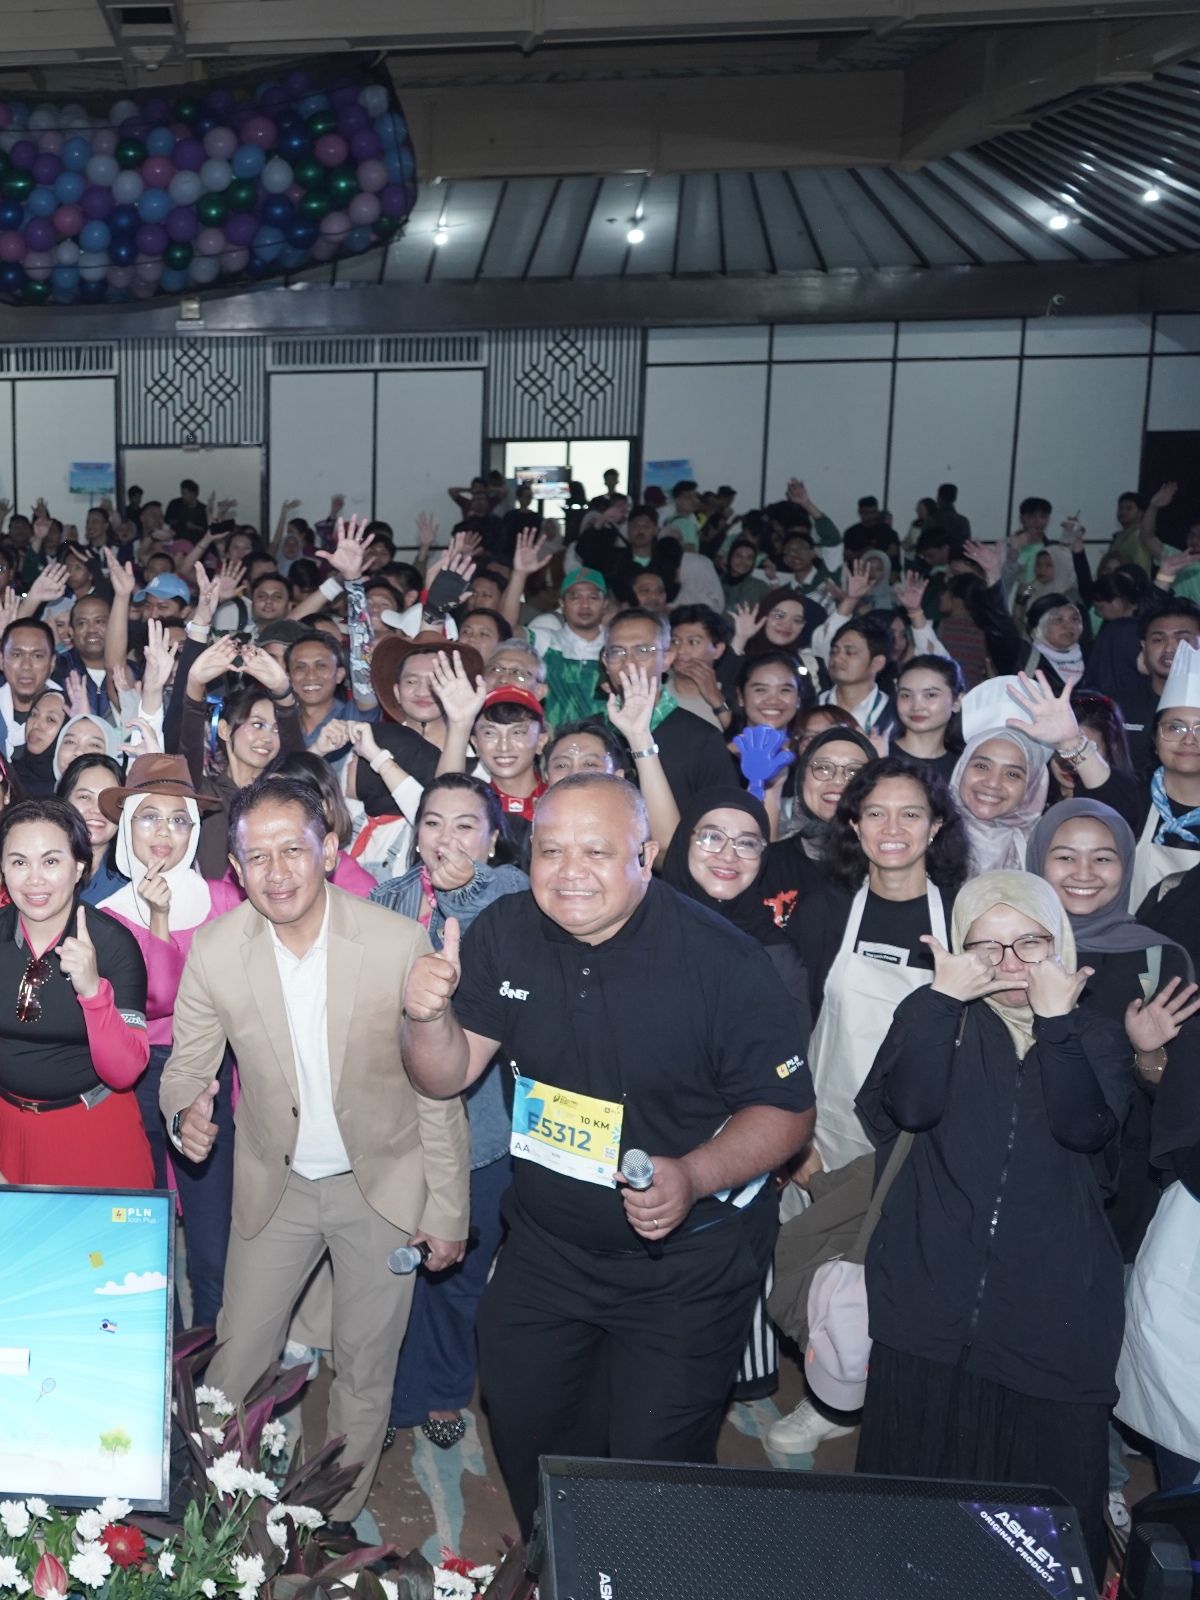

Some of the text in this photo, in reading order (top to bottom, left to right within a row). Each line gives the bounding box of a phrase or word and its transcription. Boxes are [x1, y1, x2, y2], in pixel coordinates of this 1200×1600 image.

[528, 1111, 591, 1152] E5312
[580, 1116, 610, 1131] 10 KM
[514, 1142, 530, 1153] AA
[127, 1208, 152, 1217] PLN
[980, 1511, 1055, 1582] ORIGINAL PRODUCT
[994, 1512, 1062, 1569] ASHLEY
